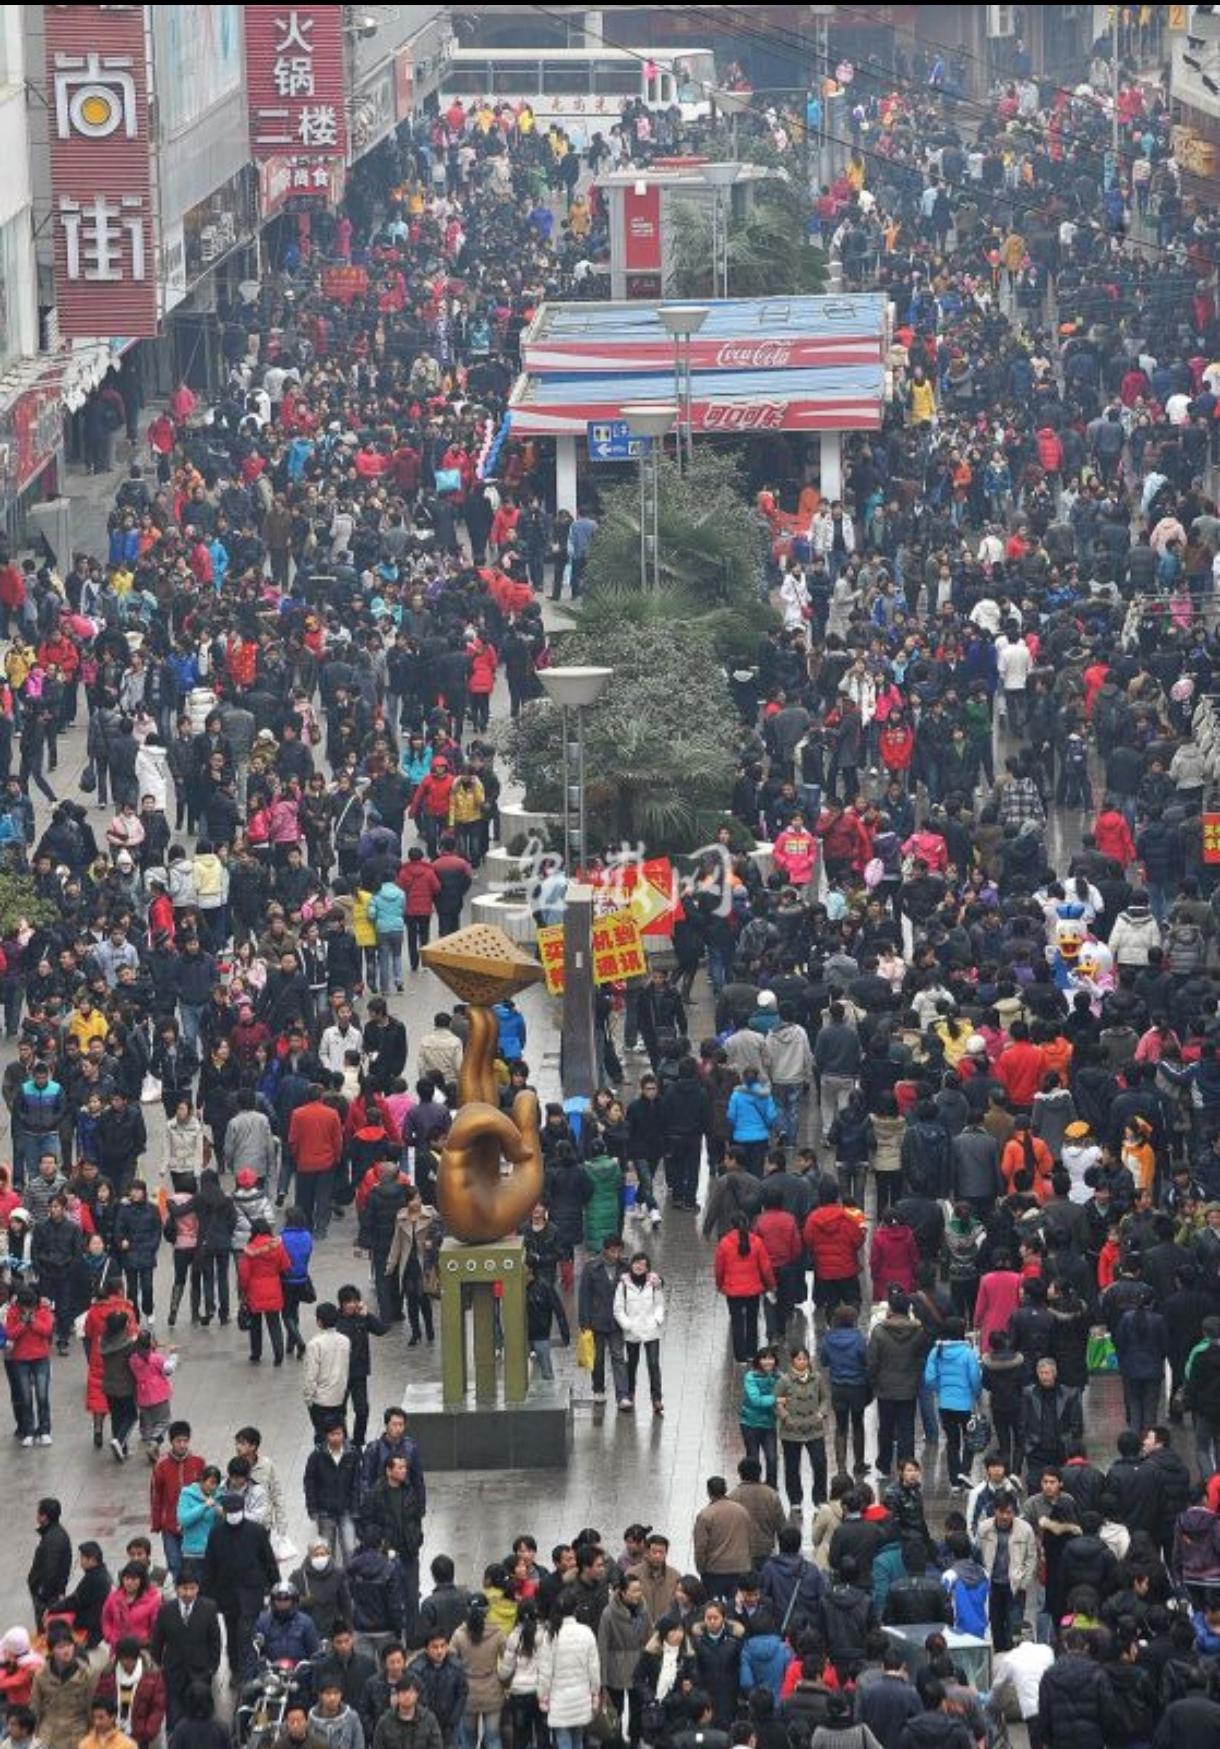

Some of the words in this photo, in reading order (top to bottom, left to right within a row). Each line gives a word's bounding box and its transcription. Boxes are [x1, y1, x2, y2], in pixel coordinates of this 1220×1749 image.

[274, 11, 315, 97] 火锅
[54, 5, 145, 281] 尚街
[256, 105, 338, 146] 二楼
[704, 401, 787, 430] 可口可乐
